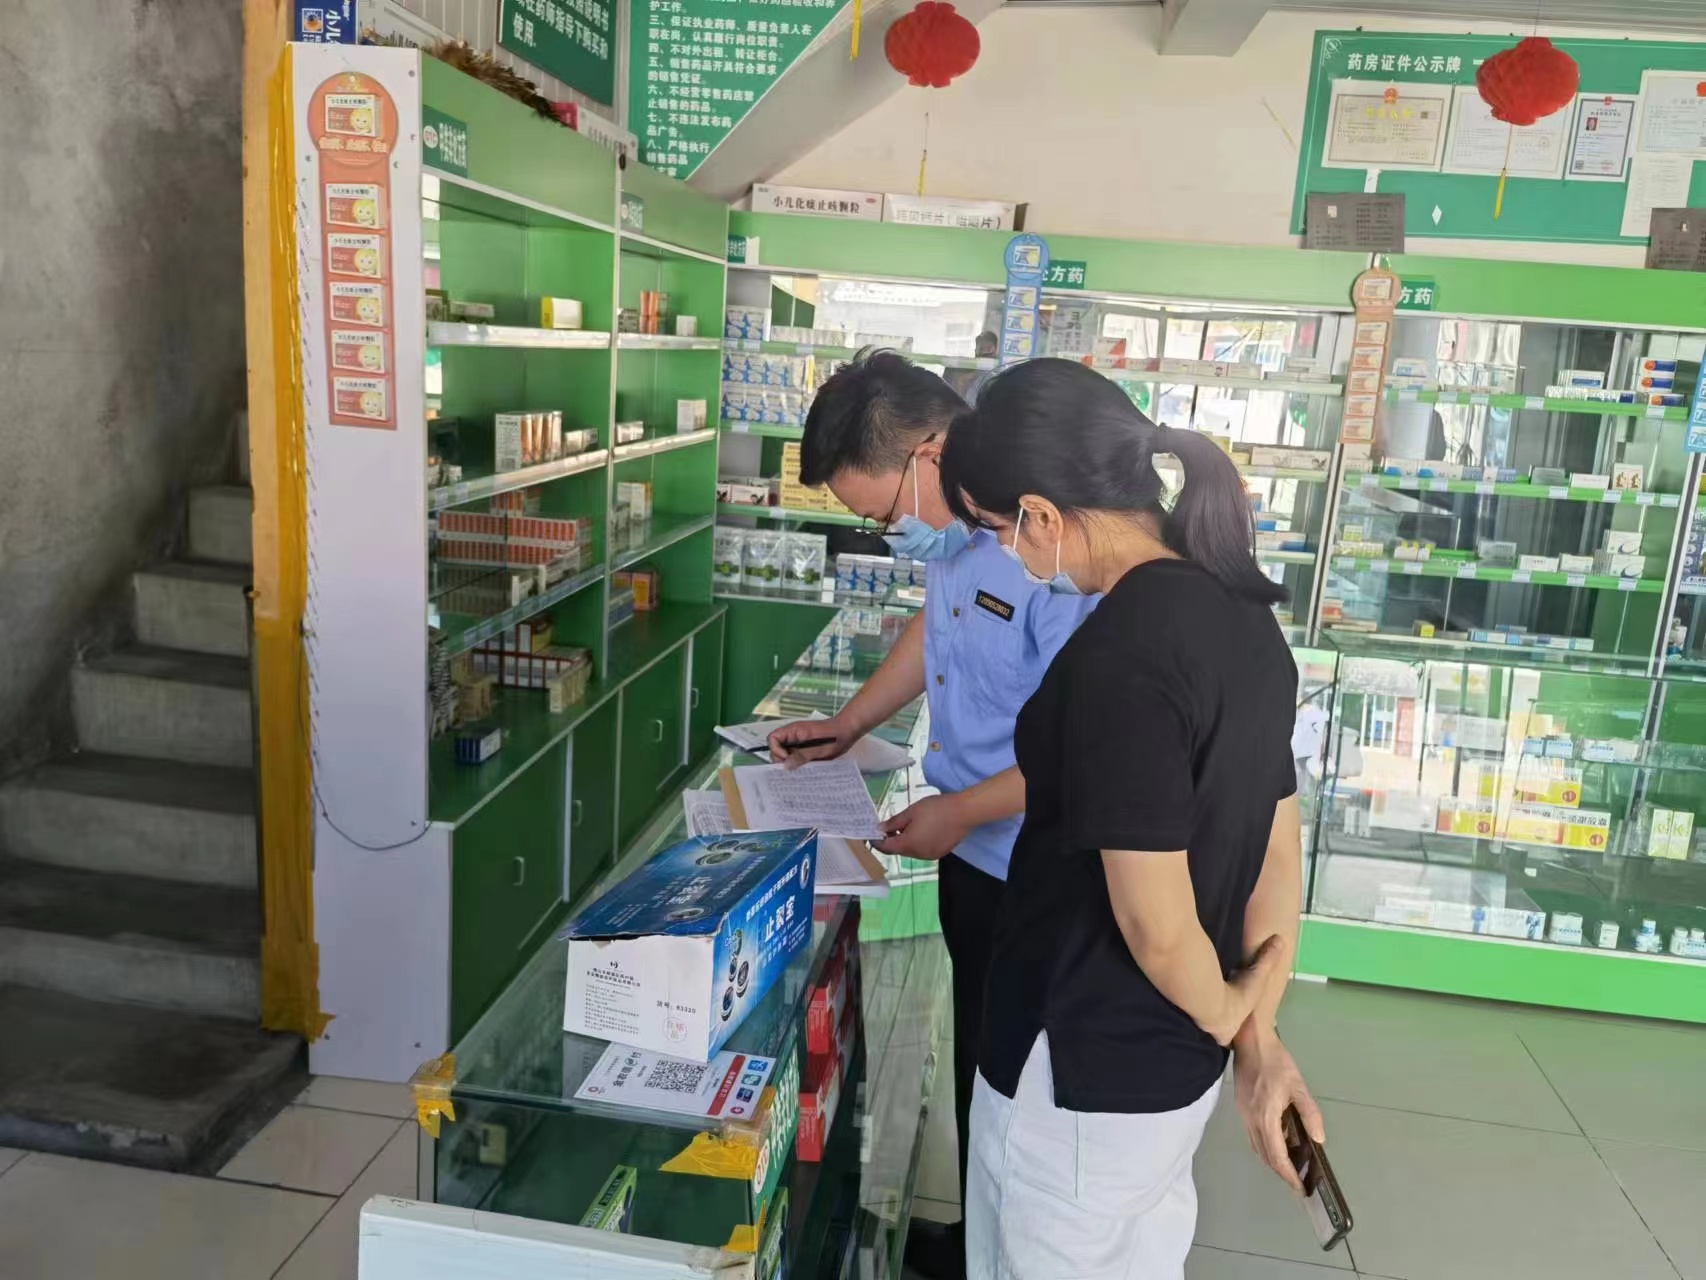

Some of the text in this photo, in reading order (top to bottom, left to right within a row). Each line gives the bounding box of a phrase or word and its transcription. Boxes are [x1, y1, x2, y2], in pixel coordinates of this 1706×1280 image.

[1347, 53, 1462, 73] 药房证件公示牌
[774, 195, 860, 214] 小儿化痰止咳颗粒
